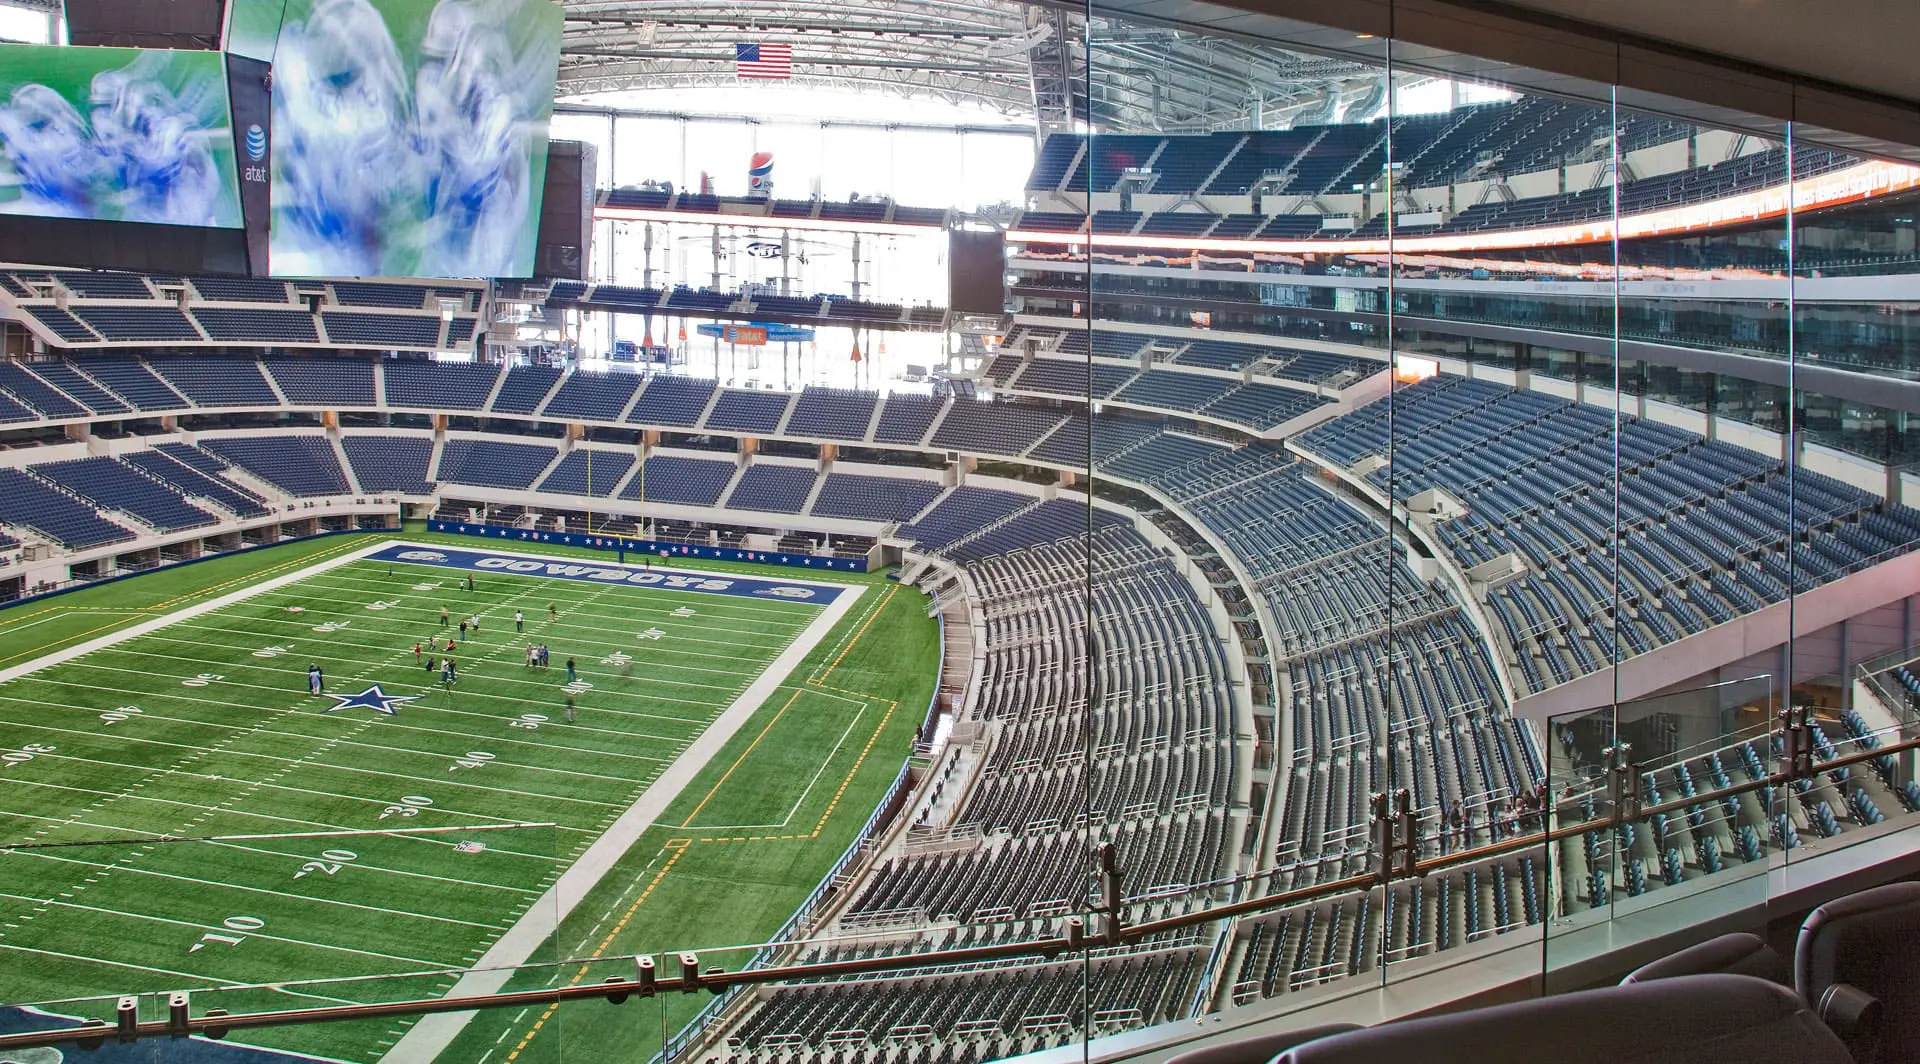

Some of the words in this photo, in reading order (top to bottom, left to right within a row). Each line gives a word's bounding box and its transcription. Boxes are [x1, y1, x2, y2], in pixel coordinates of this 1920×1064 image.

[245, 165, 267, 183] at&t
[474, 558, 735, 591] COWBOYS
[181, 673, 226, 687] 50
[99, 705, 144, 721] 40
[509, 714, 549, 730] 50
[0, 743, 57, 761] 30
[455, 751, 496, 769] 40
[384, 795, 434, 818] 30
[302, 849, 358, 876] 20
[200, 916, 265, 948] 10
